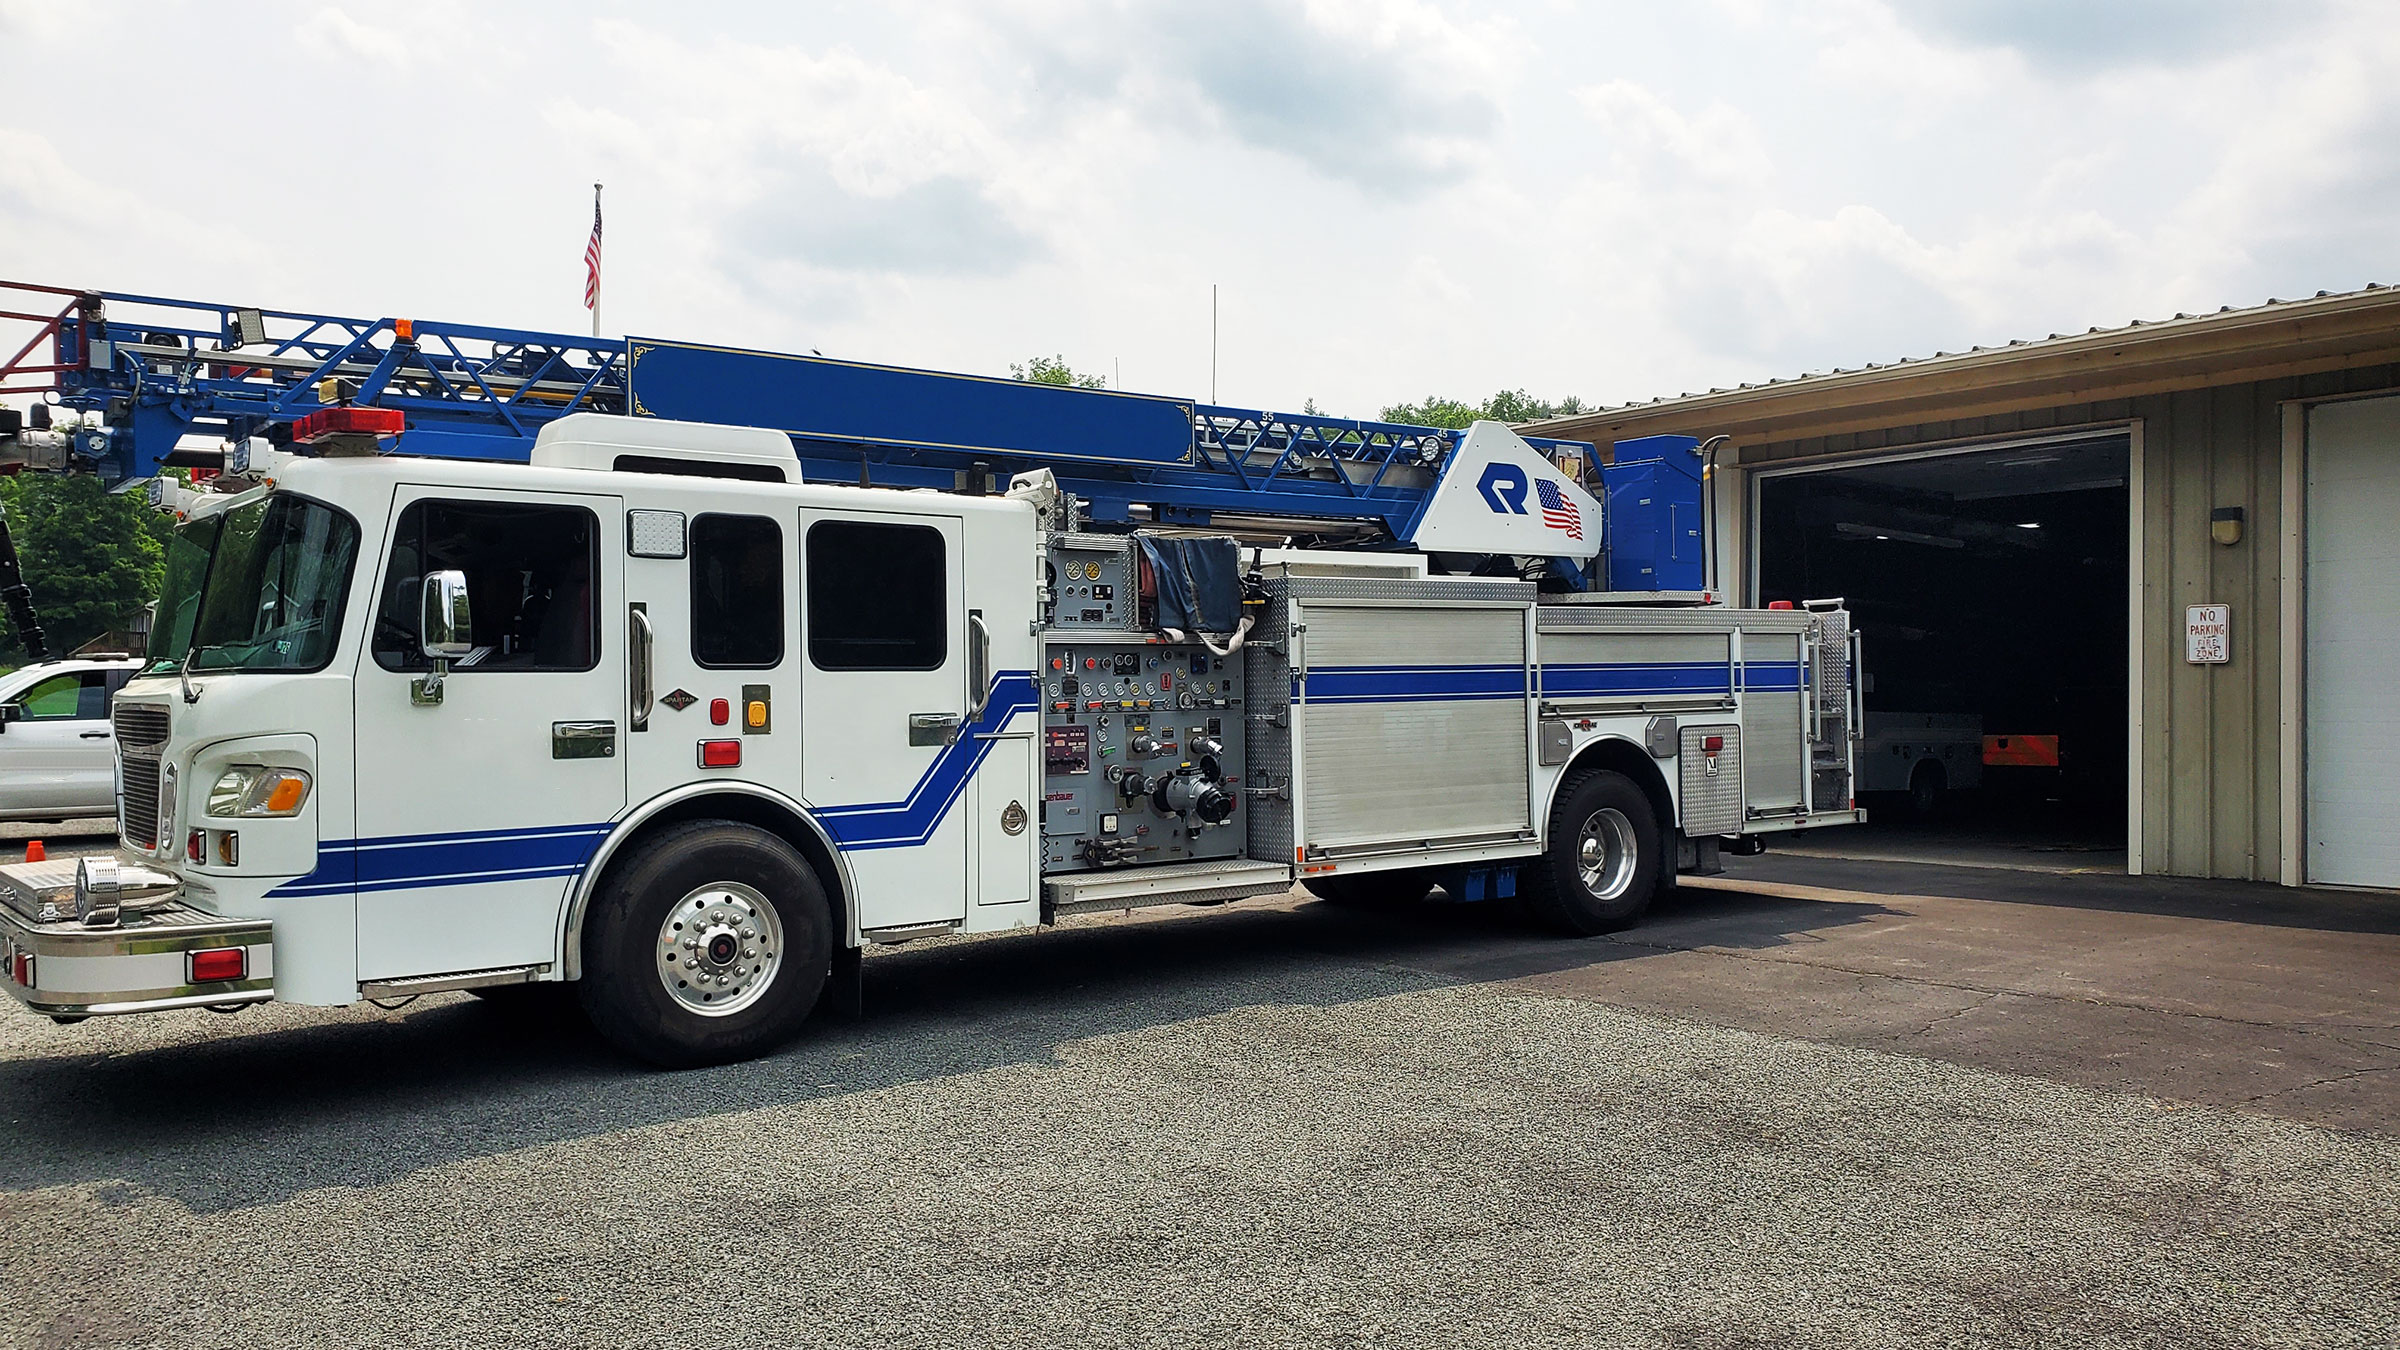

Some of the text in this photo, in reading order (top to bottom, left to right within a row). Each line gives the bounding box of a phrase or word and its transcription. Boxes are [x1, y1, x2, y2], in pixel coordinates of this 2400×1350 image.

[1262, 411, 1274, 421] 55
[1437, 428, 1448, 438] 45
[1476, 462, 1529, 515] R
[2200, 611, 2215, 621] NO
[2190, 624, 2224, 635] PARKING
[2198, 639, 2217, 647] FIRE
[2196, 649, 2218, 657] ZONE
